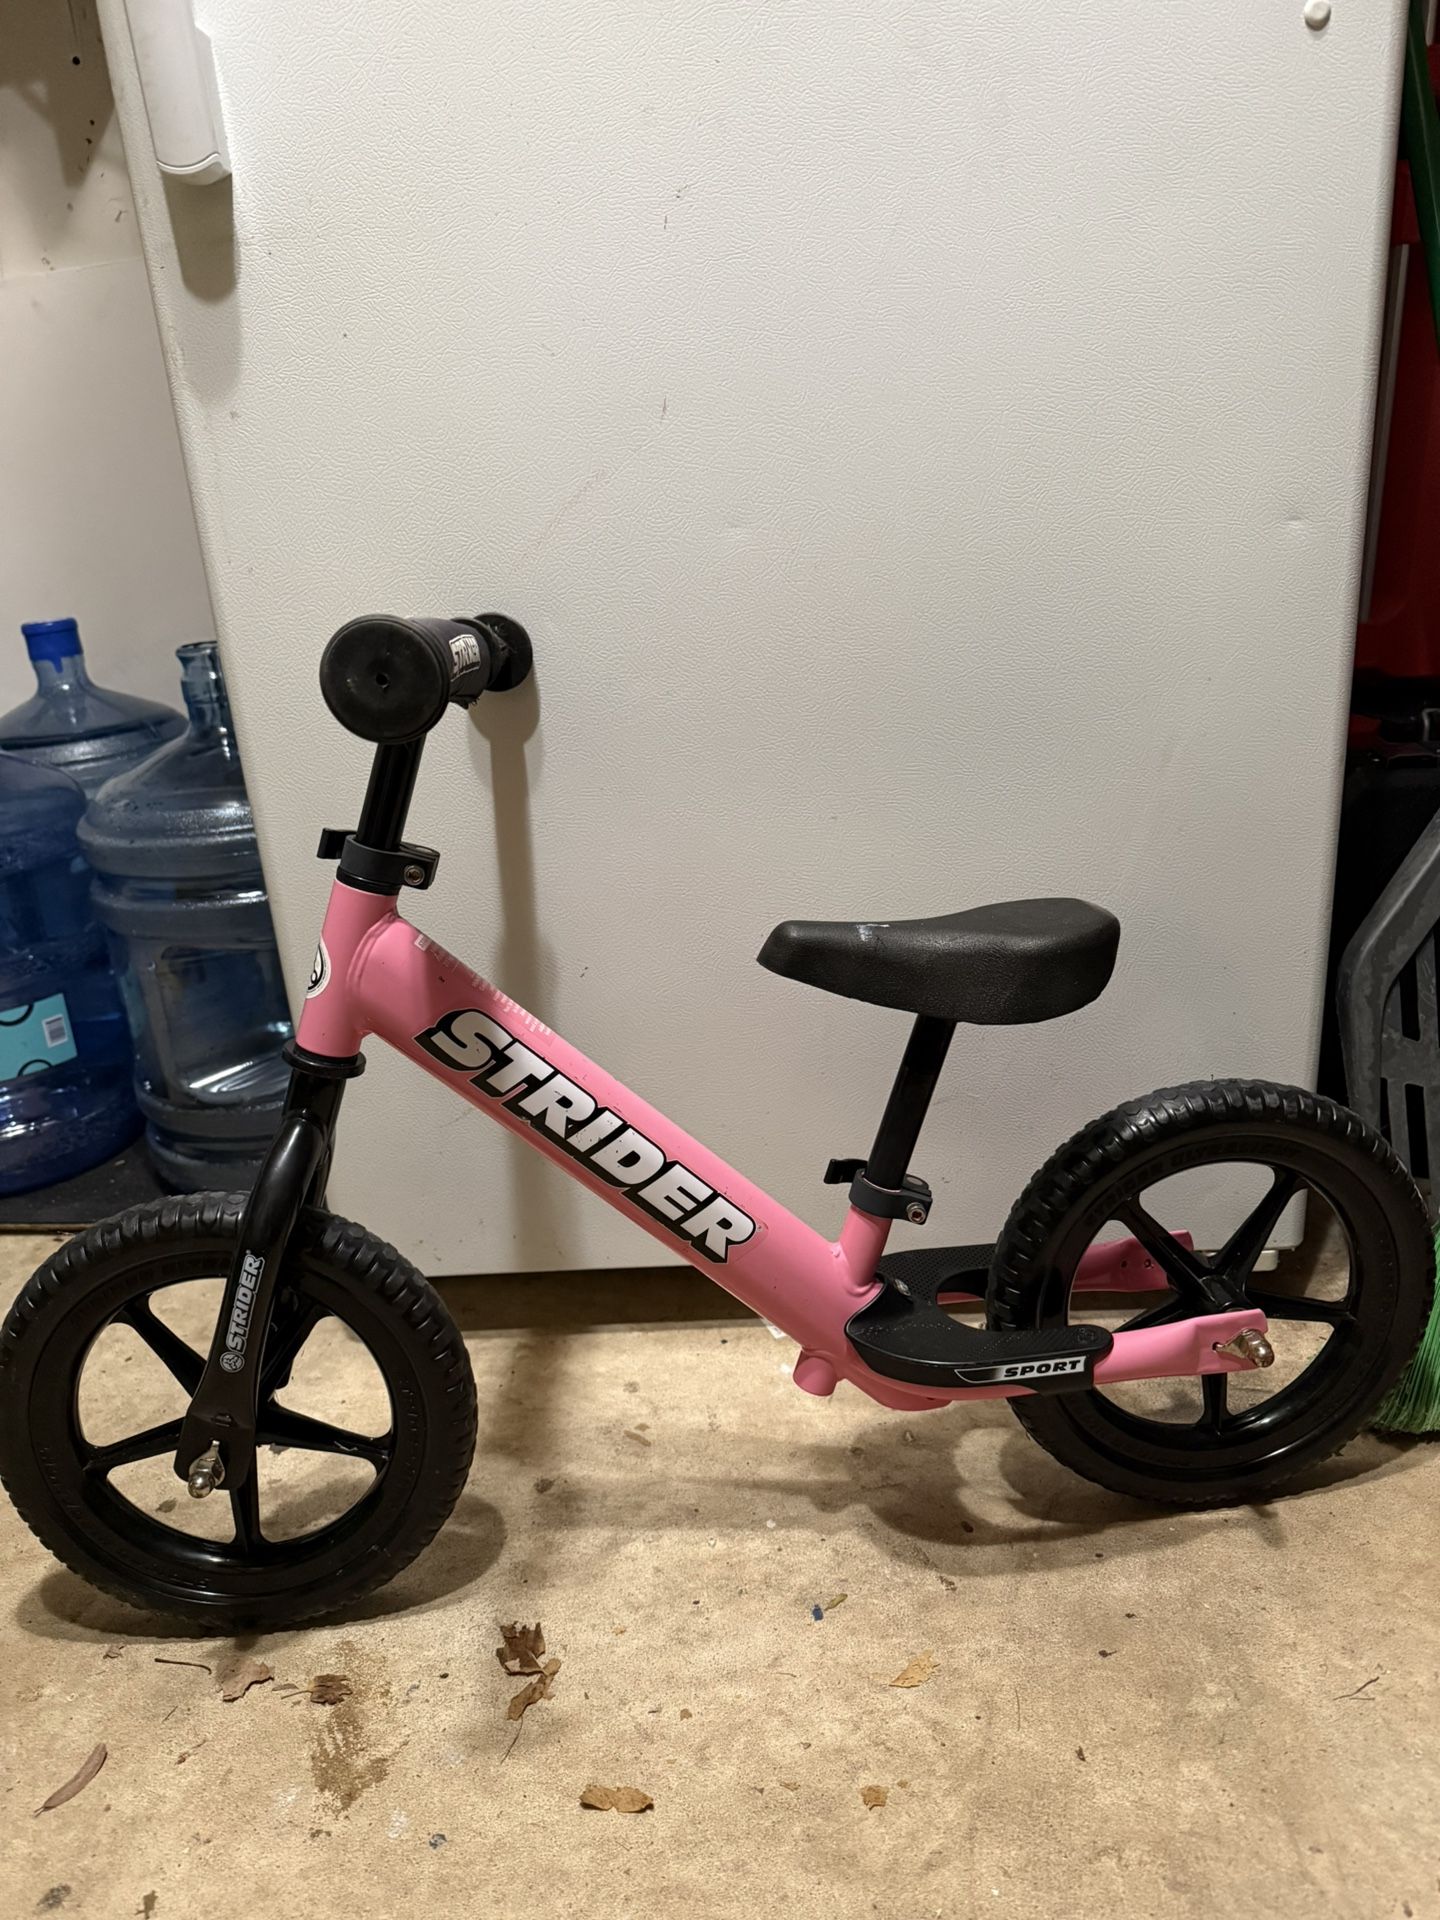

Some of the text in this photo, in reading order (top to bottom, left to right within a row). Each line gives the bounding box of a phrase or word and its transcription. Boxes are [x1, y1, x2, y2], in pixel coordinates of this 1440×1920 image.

[419, 1009, 757, 1262] STRIDER
[228, 1255, 263, 1351] STRIDER
[1004, 1359, 1081, 1378] SPORT
